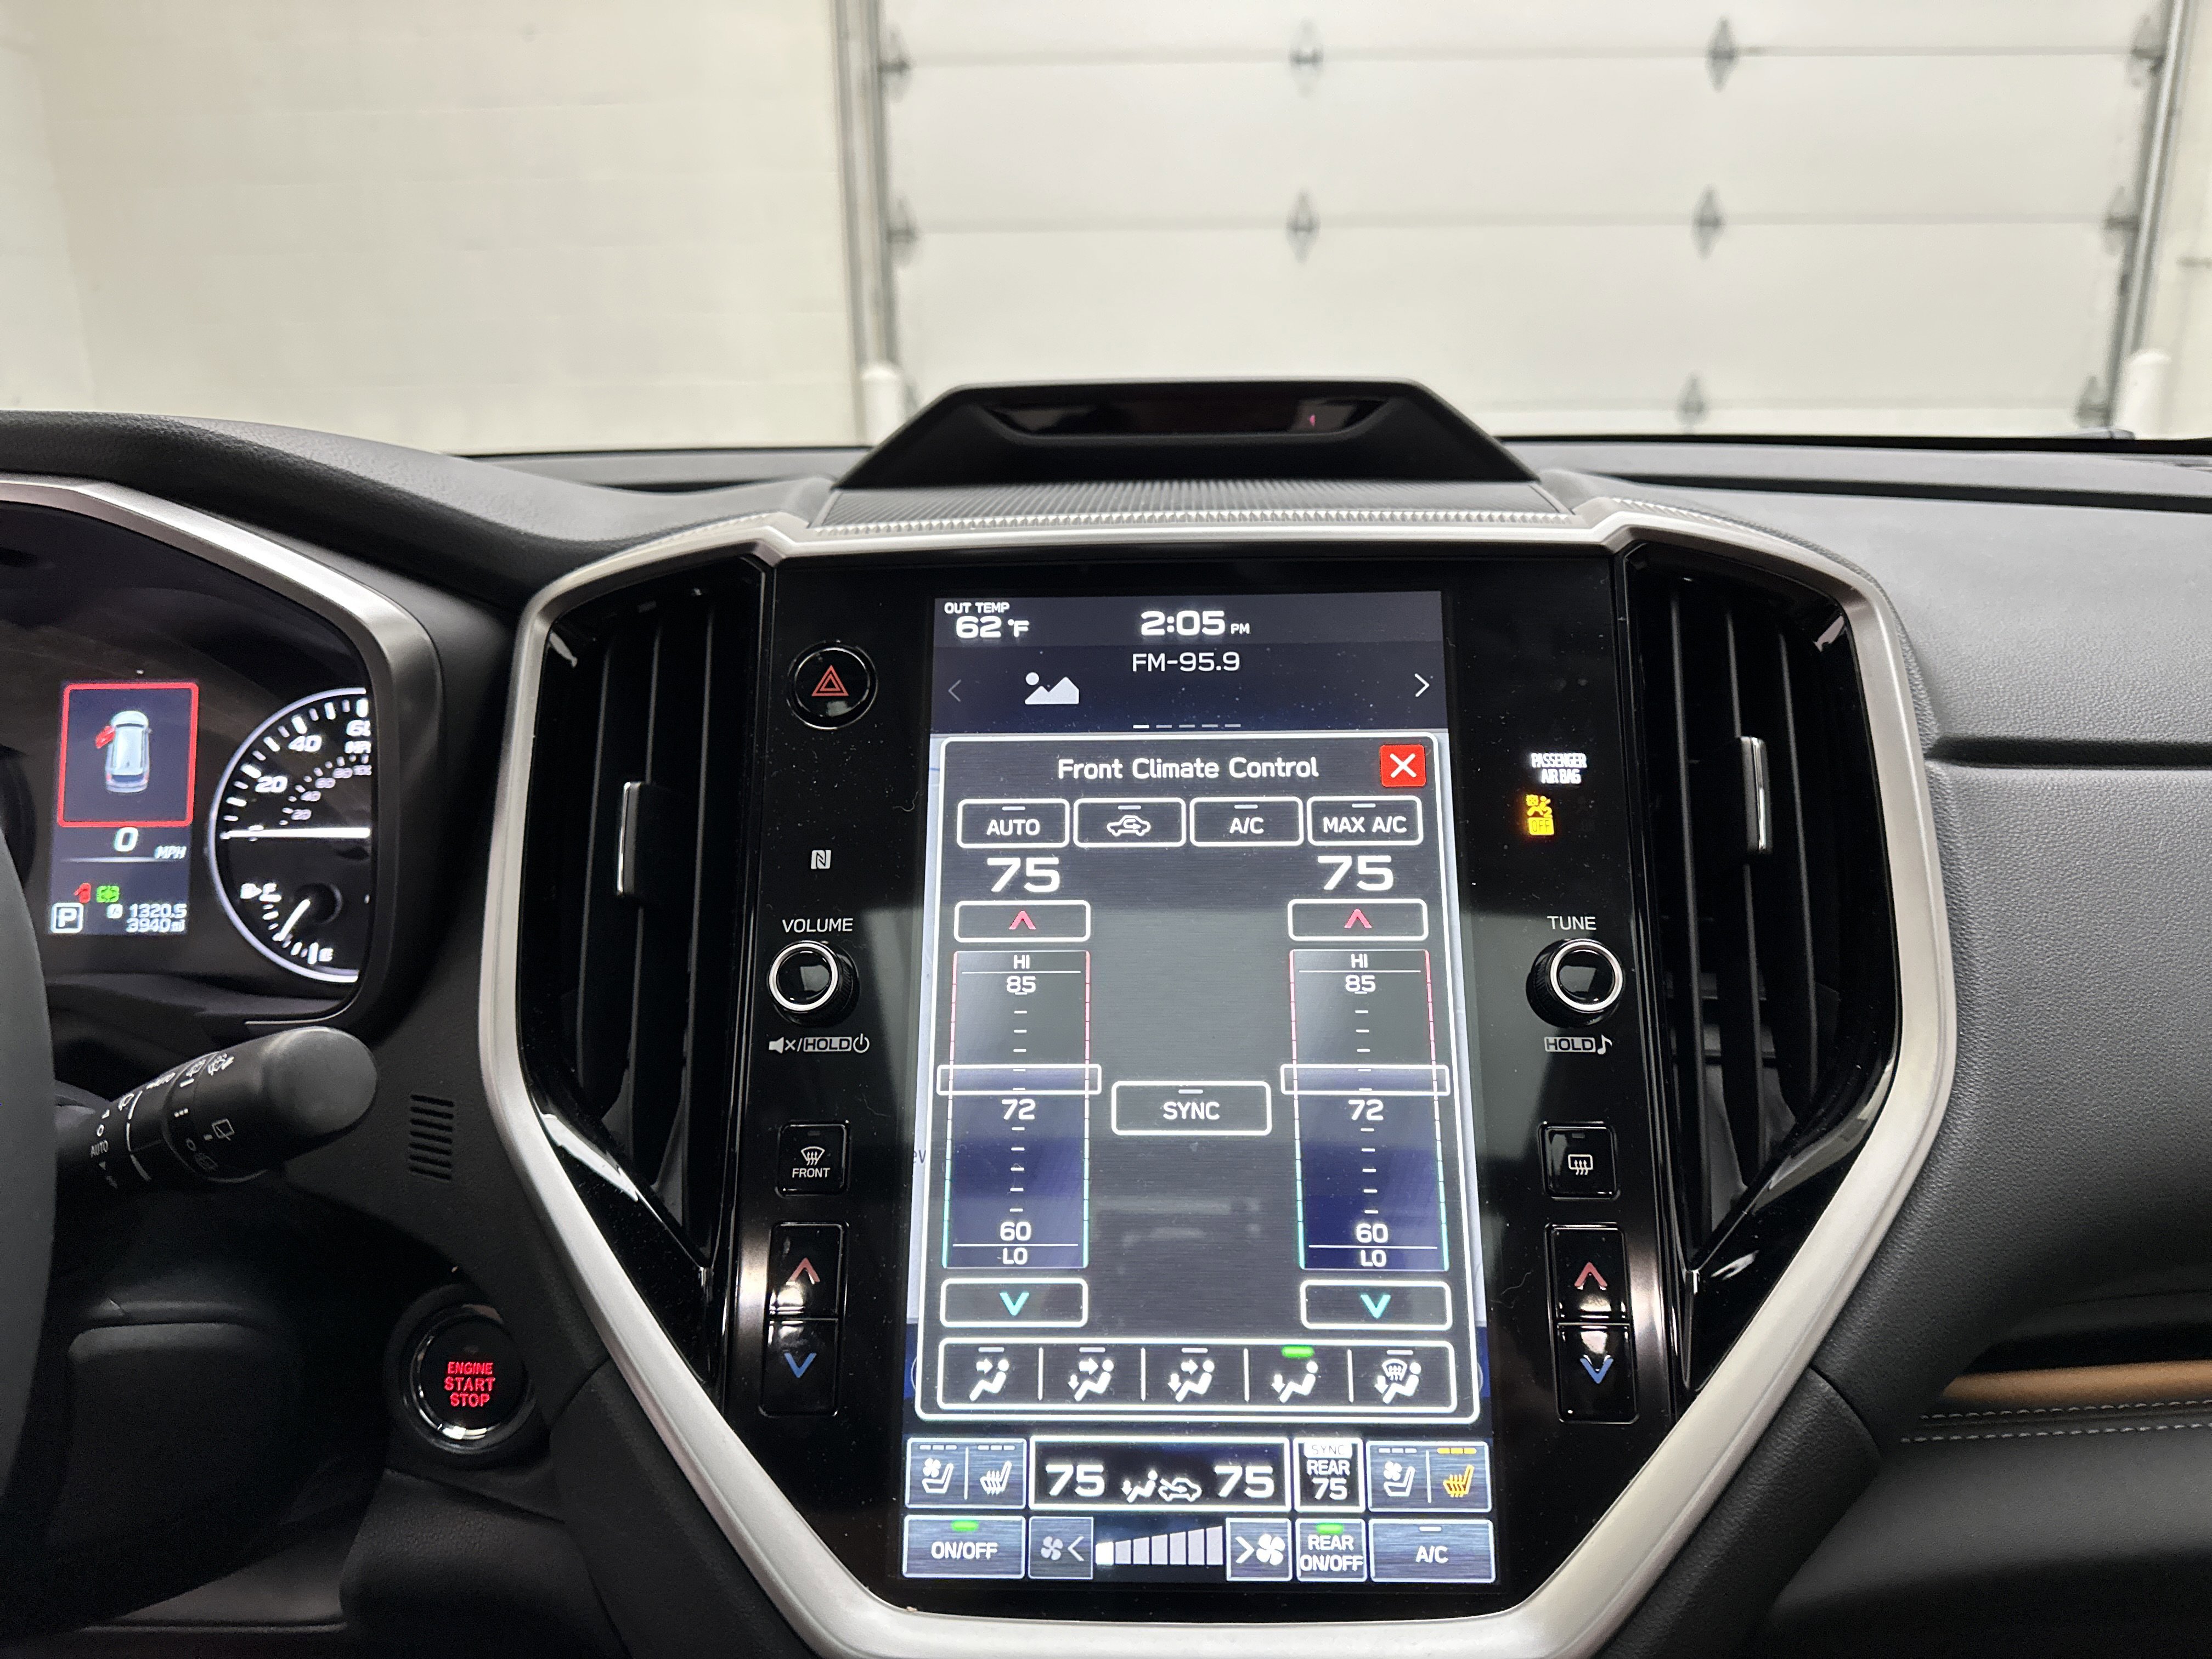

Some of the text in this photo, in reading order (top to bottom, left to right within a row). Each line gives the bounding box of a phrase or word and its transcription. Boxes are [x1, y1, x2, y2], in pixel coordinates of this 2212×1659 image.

[944, 602, 1010, 614] OUT TEMP
[956, 615, 1002, 639] 62
[1141, 610, 1250, 636] 2:05 PM
[1132, 651, 1240, 672] FM-95.9
[288, 735, 322, 752] 40
[1058, 757, 1319, 780] Front Climate Control
[1531, 753, 1587, 768] PASSENGER
[255, 776, 287, 793] 20
[1541, 769, 1581, 784] AIR BAG
[301, 791, 321, 802] 40
[291, 809, 312, 820] 20
[986, 819, 1040, 836] AUTO
[1229, 817, 1264, 834] A/C
[1323, 816, 1407, 833] MAX A/C
[1532, 820, 1550, 832] OFF
[114, 827, 138, 851] 0
[154, 845, 187, 859] MPH
[987, 856, 1060, 893] 75
[1317, 855, 1394, 891] 75
[782, 918, 853, 933] VOLUME
[1547, 916, 1596, 930] TUNE
[1013, 954, 1030, 969] HI
[1351, 953, 1368, 968] HI
[1006, 975, 1036, 994] 85
[1345, 974, 1376, 992] 85
[805, 1039, 850, 1051] HOLD
[1545, 1039, 1595, 1051] HOLD
[1001, 1098, 1036, 1120] 72
[1163, 1103, 1220, 1120] SYNC
[1348, 1099, 1384, 1121] 72
[792, 1167, 831, 1178] FRONT
[1000, 1221, 1031, 1242] 60
[1356, 1223, 1389, 1244] 60
[1002, 1248, 1028, 1265] LO
[1360, 1249, 1387, 1268] LO
[447, 1361, 493, 1375] ENGINE
[444, 1376, 496, 1391] START
[449, 1393, 490, 1407] STOP
[1311, 1445, 1345, 1455] SYNC
[1307, 1459, 1350, 1476] REAR
[1045, 1463, 1105, 1498] 75
[1214, 1464, 1275, 1499] 75
[1312, 1477, 1348, 1500] 75
[930, 1542, 998, 1559] ON/OFF
[1307, 1534, 1354, 1551] REAR
[1299, 1554, 1364, 1572] ON/OFF
[1415, 1545, 1448, 1564] A/C
